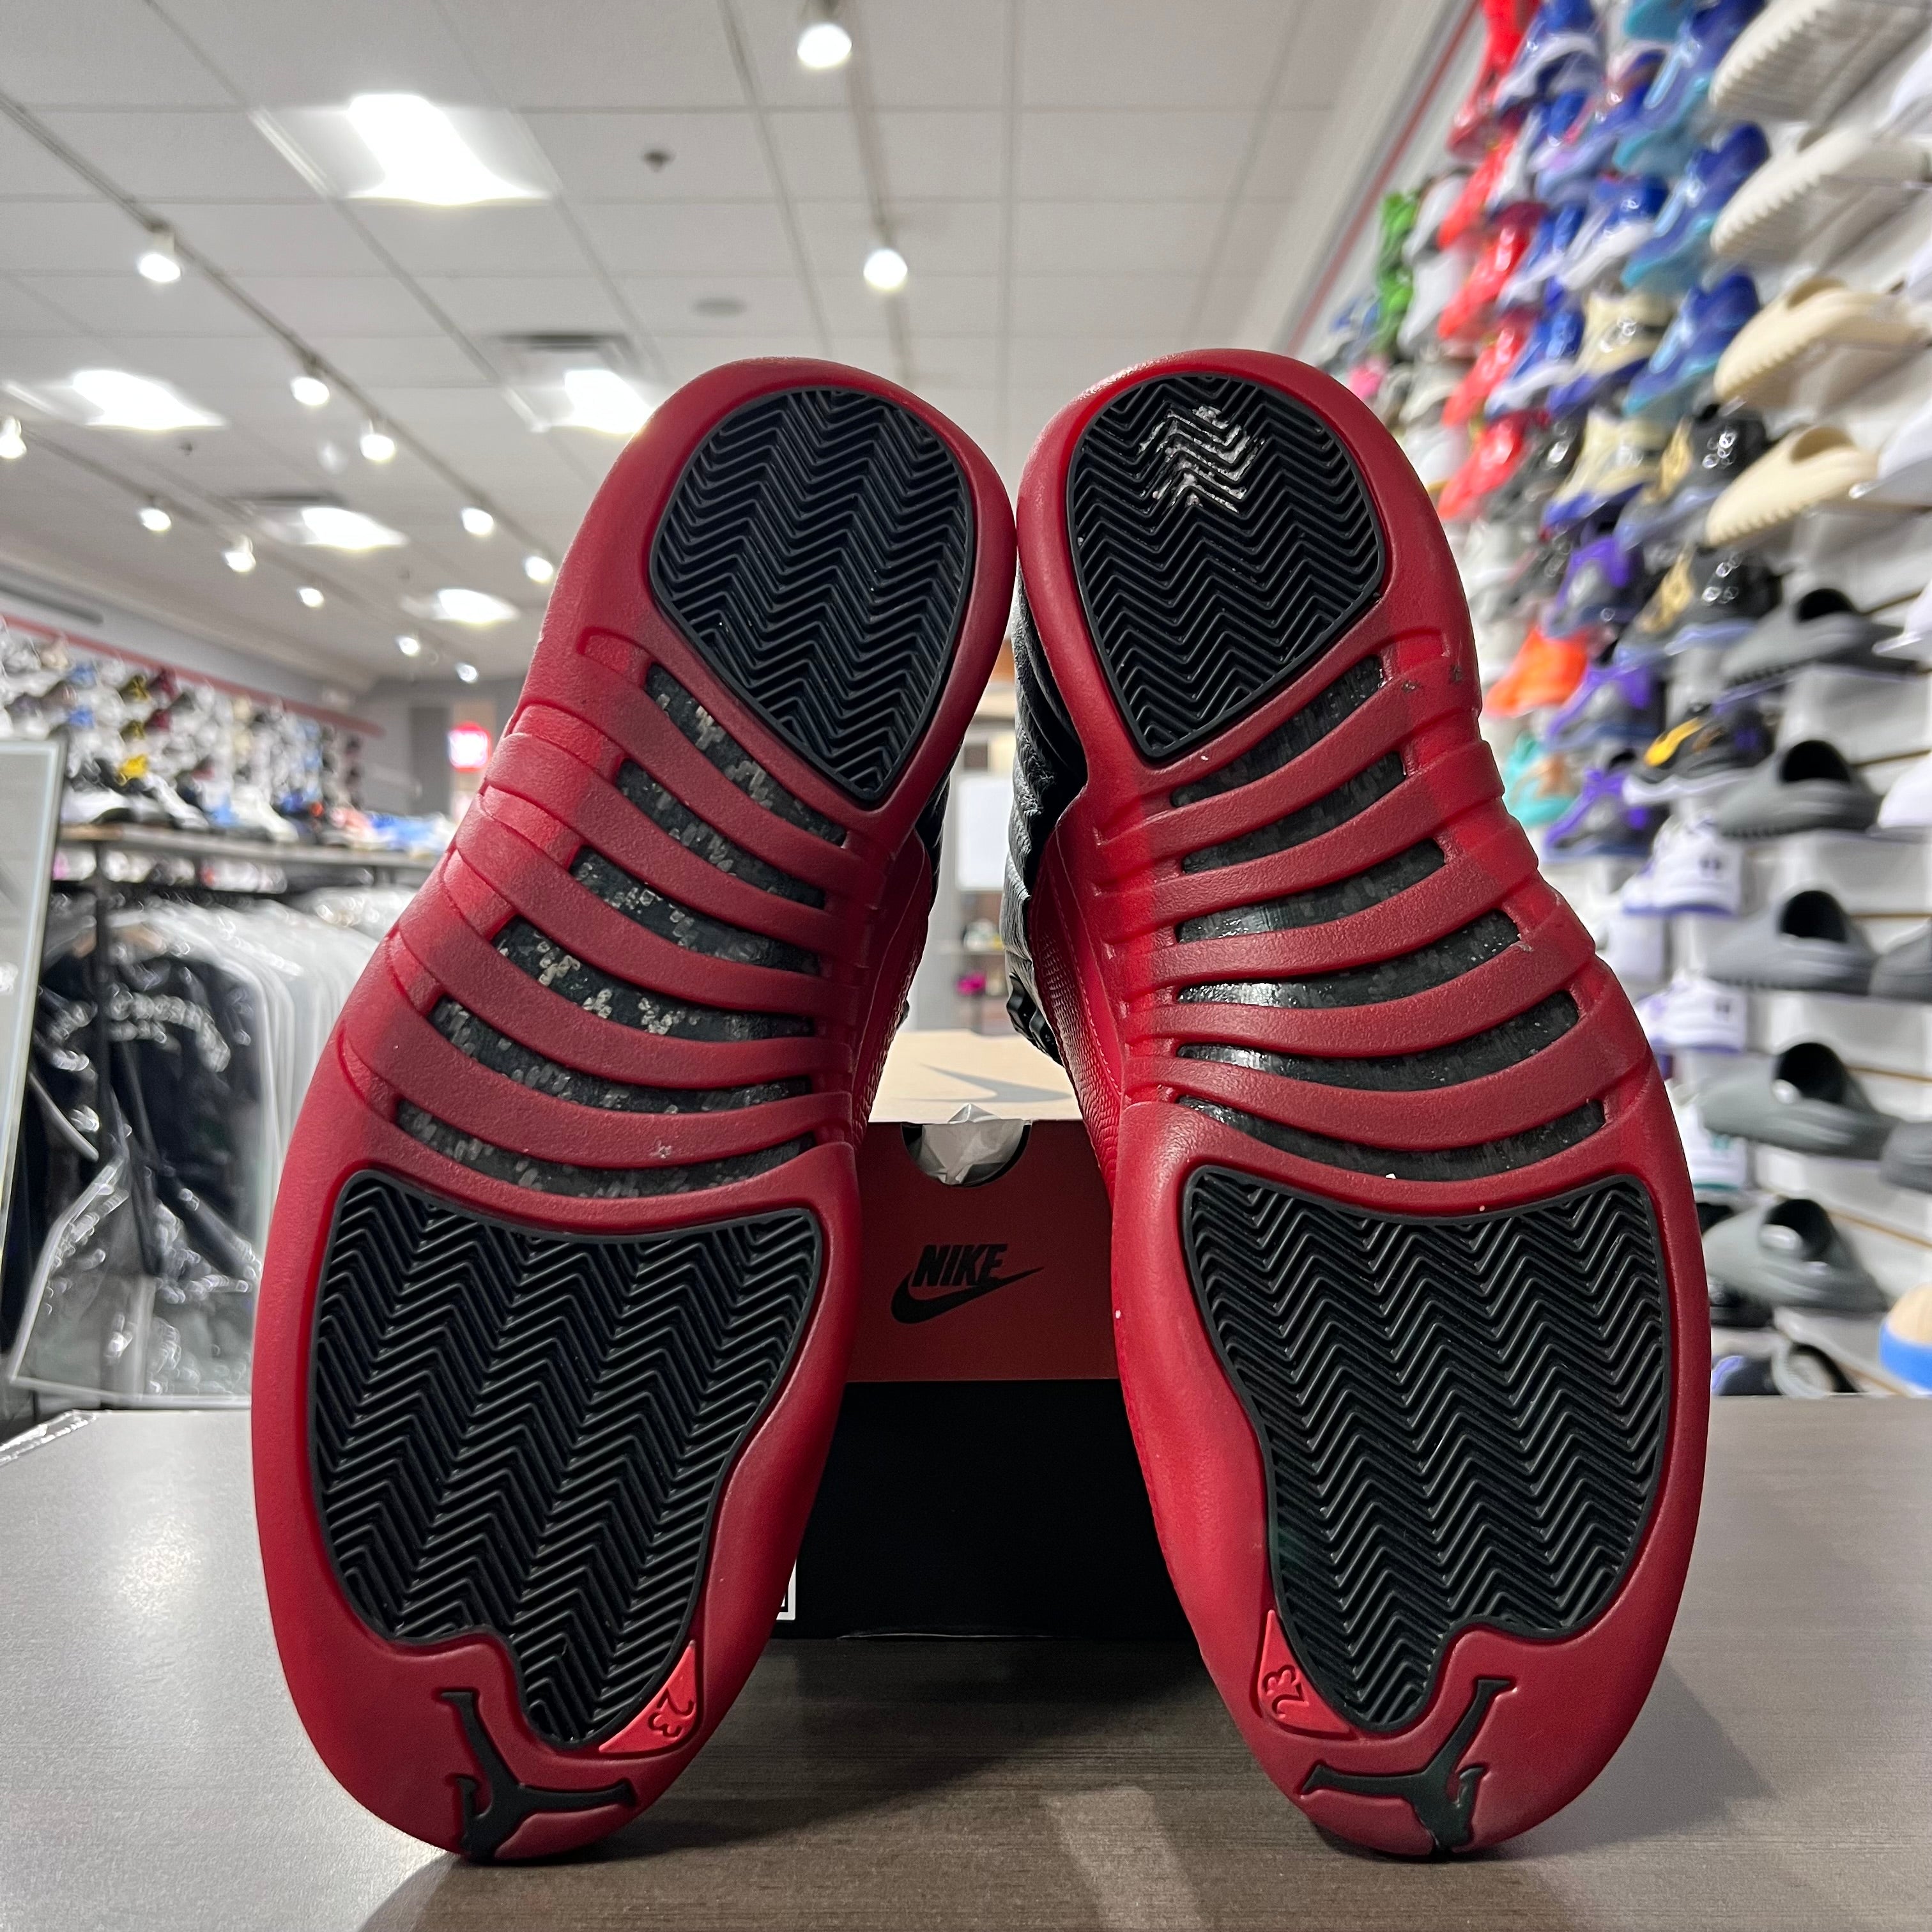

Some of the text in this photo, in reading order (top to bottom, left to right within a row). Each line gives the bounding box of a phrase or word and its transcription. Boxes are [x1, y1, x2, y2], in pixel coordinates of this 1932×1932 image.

[911, 1243, 1008, 1287] NIKE
[647, 1687, 695, 1738] 23
[1262, 1664, 1307, 1715] 23
